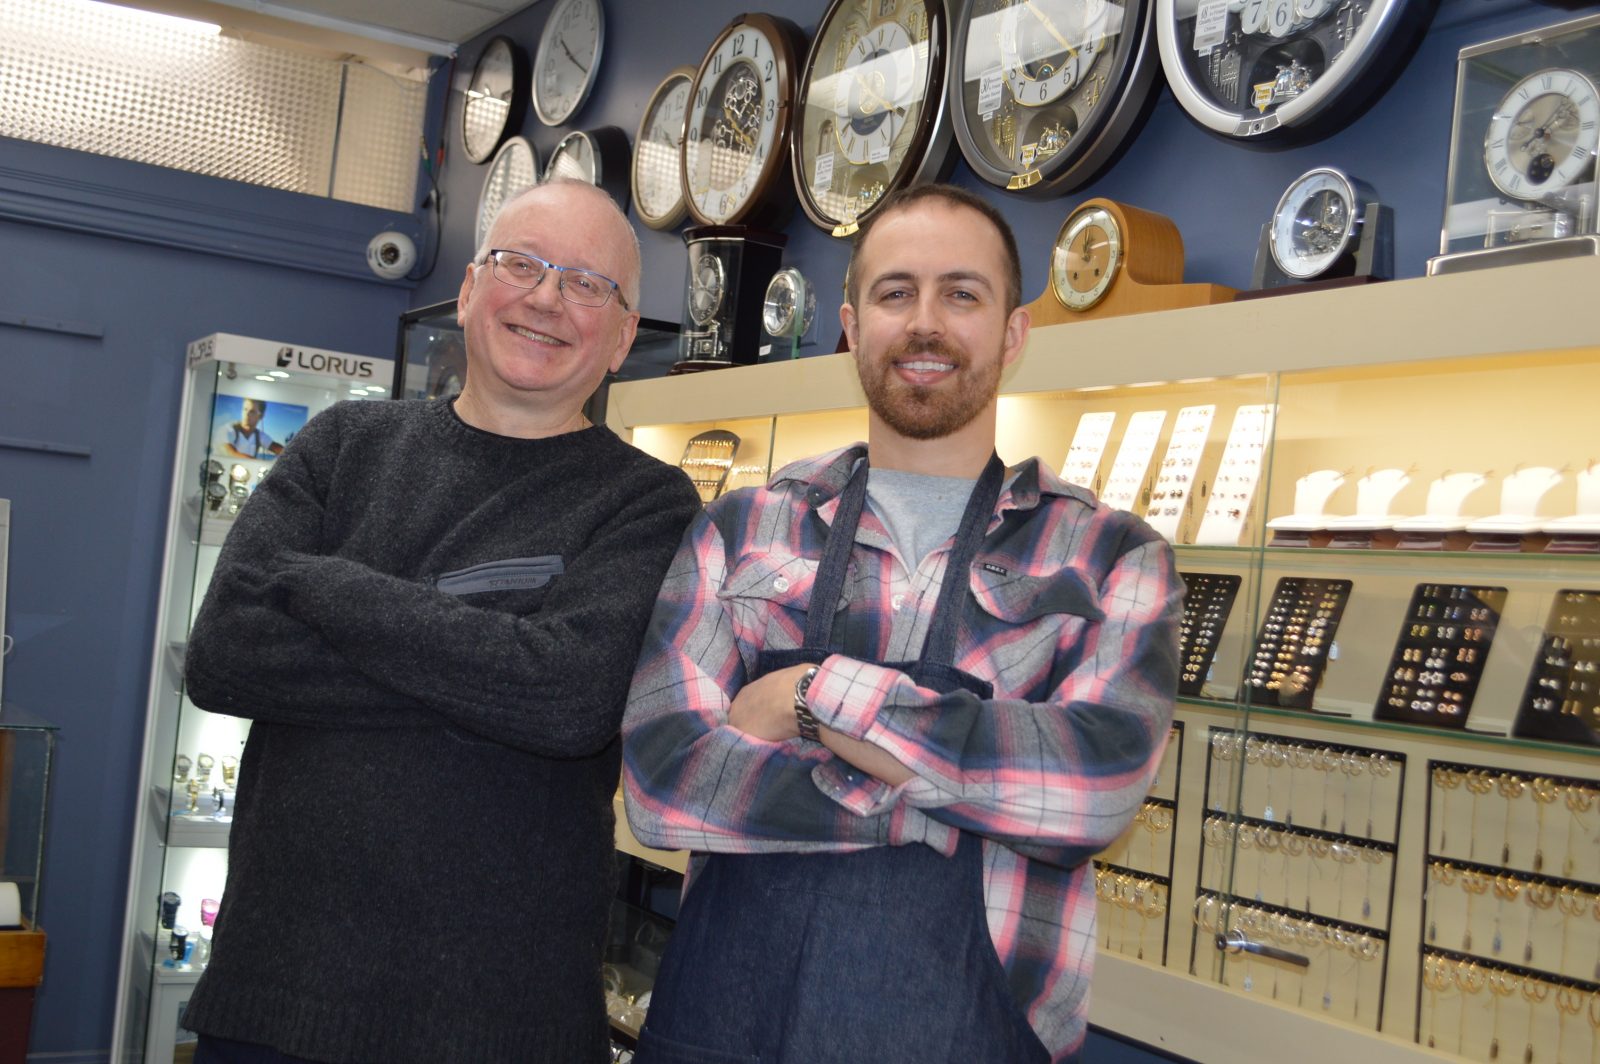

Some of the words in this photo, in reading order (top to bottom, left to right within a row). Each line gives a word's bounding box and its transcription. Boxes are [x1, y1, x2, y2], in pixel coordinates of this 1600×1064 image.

[1250, 1, 1261, 25] 7
[1275, 2, 1287, 27] 6
[732, 33, 744, 57] 12
[754, 38, 760, 57] 1
[1084, 34, 1094, 54] 4
[713, 53, 722, 75] 11
[765, 60, 773, 82] 2
[1063, 66, 1071, 85] 5
[697, 86, 708, 108] 10
[1018, 80, 1026, 100] 7
[1040, 82, 1047, 101] 6
[766, 100, 775, 122] 3
[298, 351, 374, 378] LORUS
